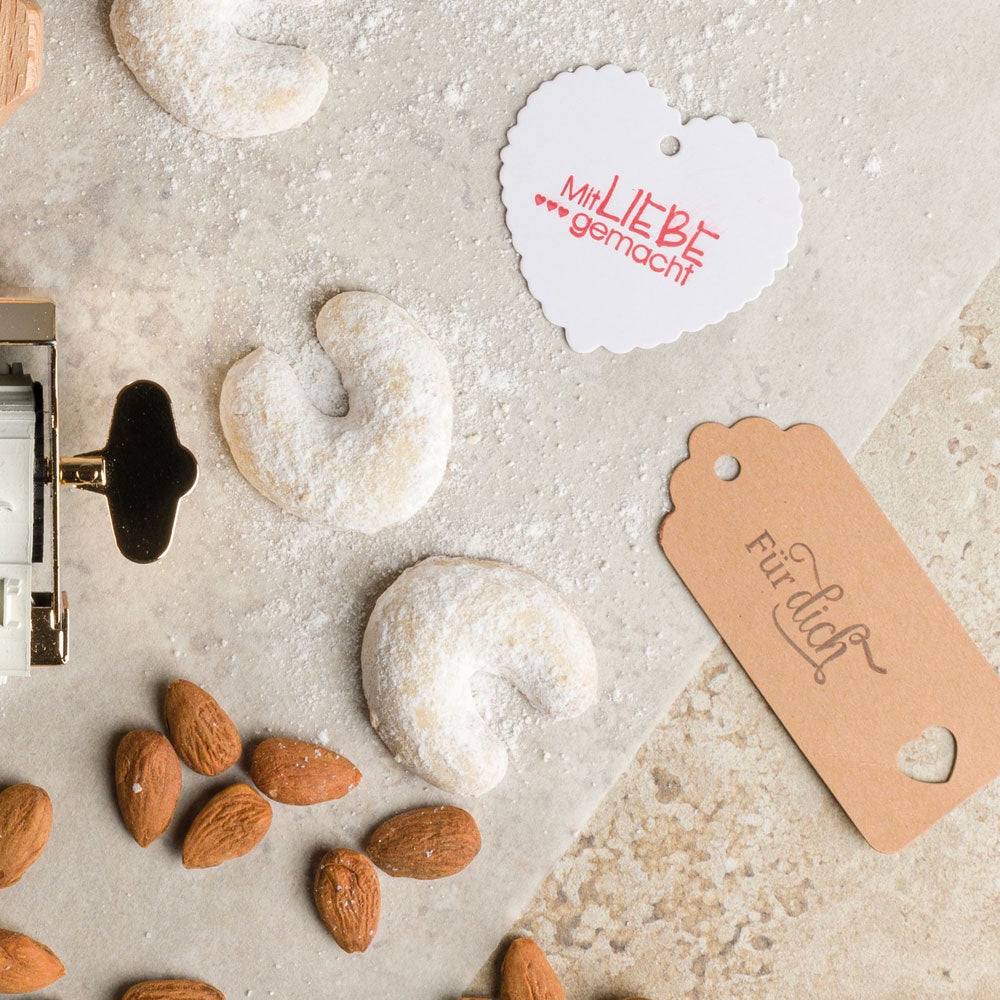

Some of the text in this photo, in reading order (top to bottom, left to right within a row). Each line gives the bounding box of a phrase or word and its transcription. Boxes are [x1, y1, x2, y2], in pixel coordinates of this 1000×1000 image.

[560, 174, 721, 268] Mit LIEBE
[568, 212, 696, 287] gemacht
[744, 528, 888, 685] Für dich
